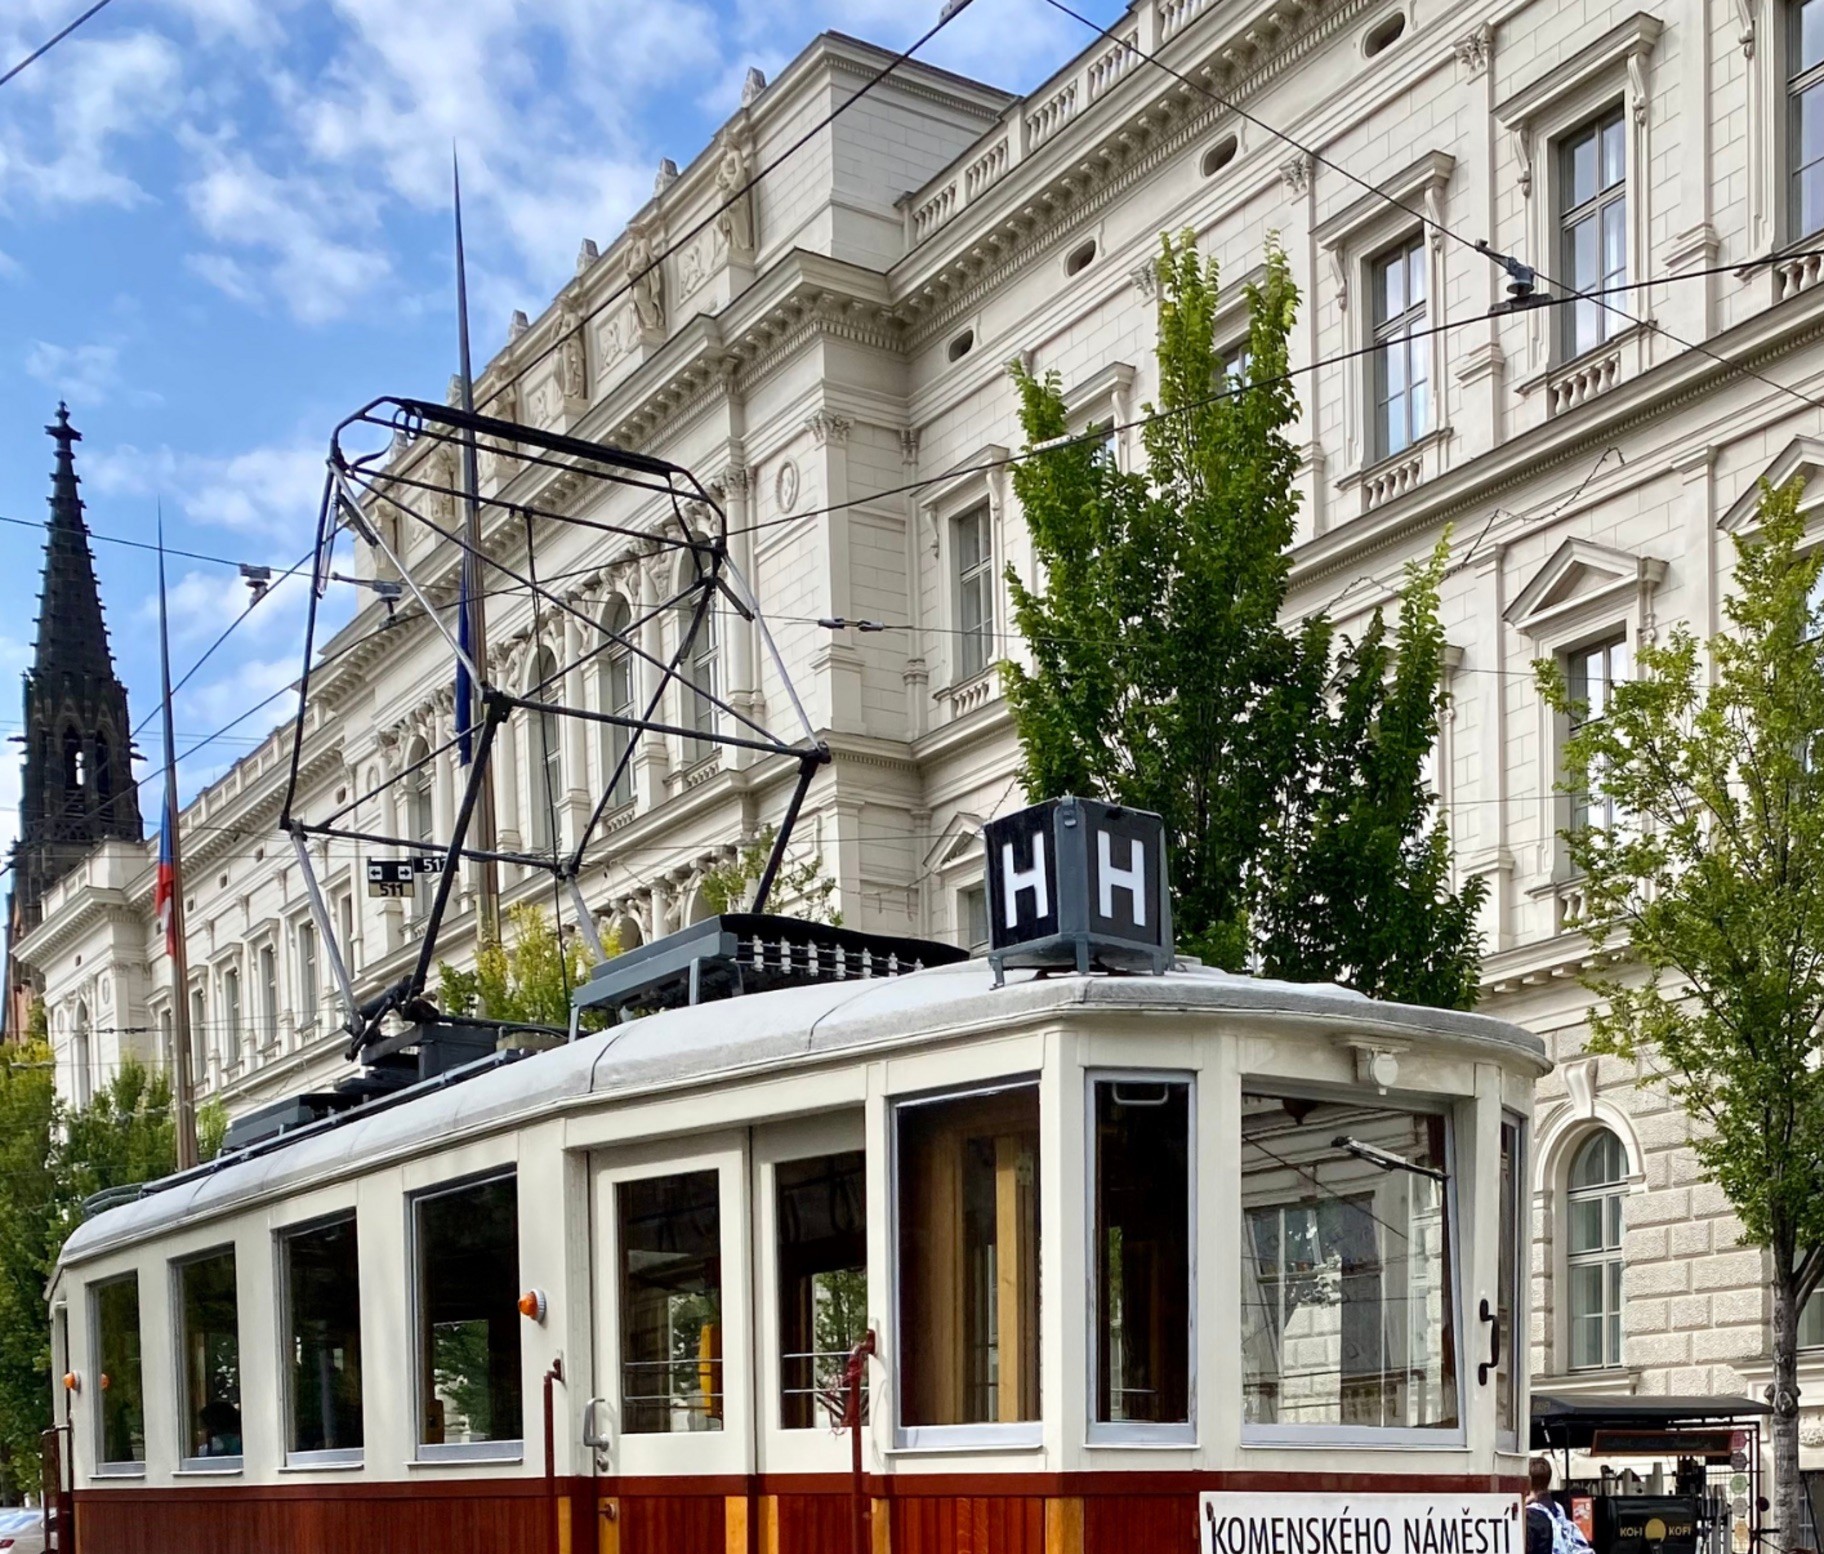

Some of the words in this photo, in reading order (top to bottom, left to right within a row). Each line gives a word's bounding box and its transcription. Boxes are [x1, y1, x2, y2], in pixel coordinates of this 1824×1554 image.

[1003, 831, 1049, 929] H
[1097, 829, 1146, 927] H
[1403, 1506, 1511, 1554] NÁMĚSTÍ
